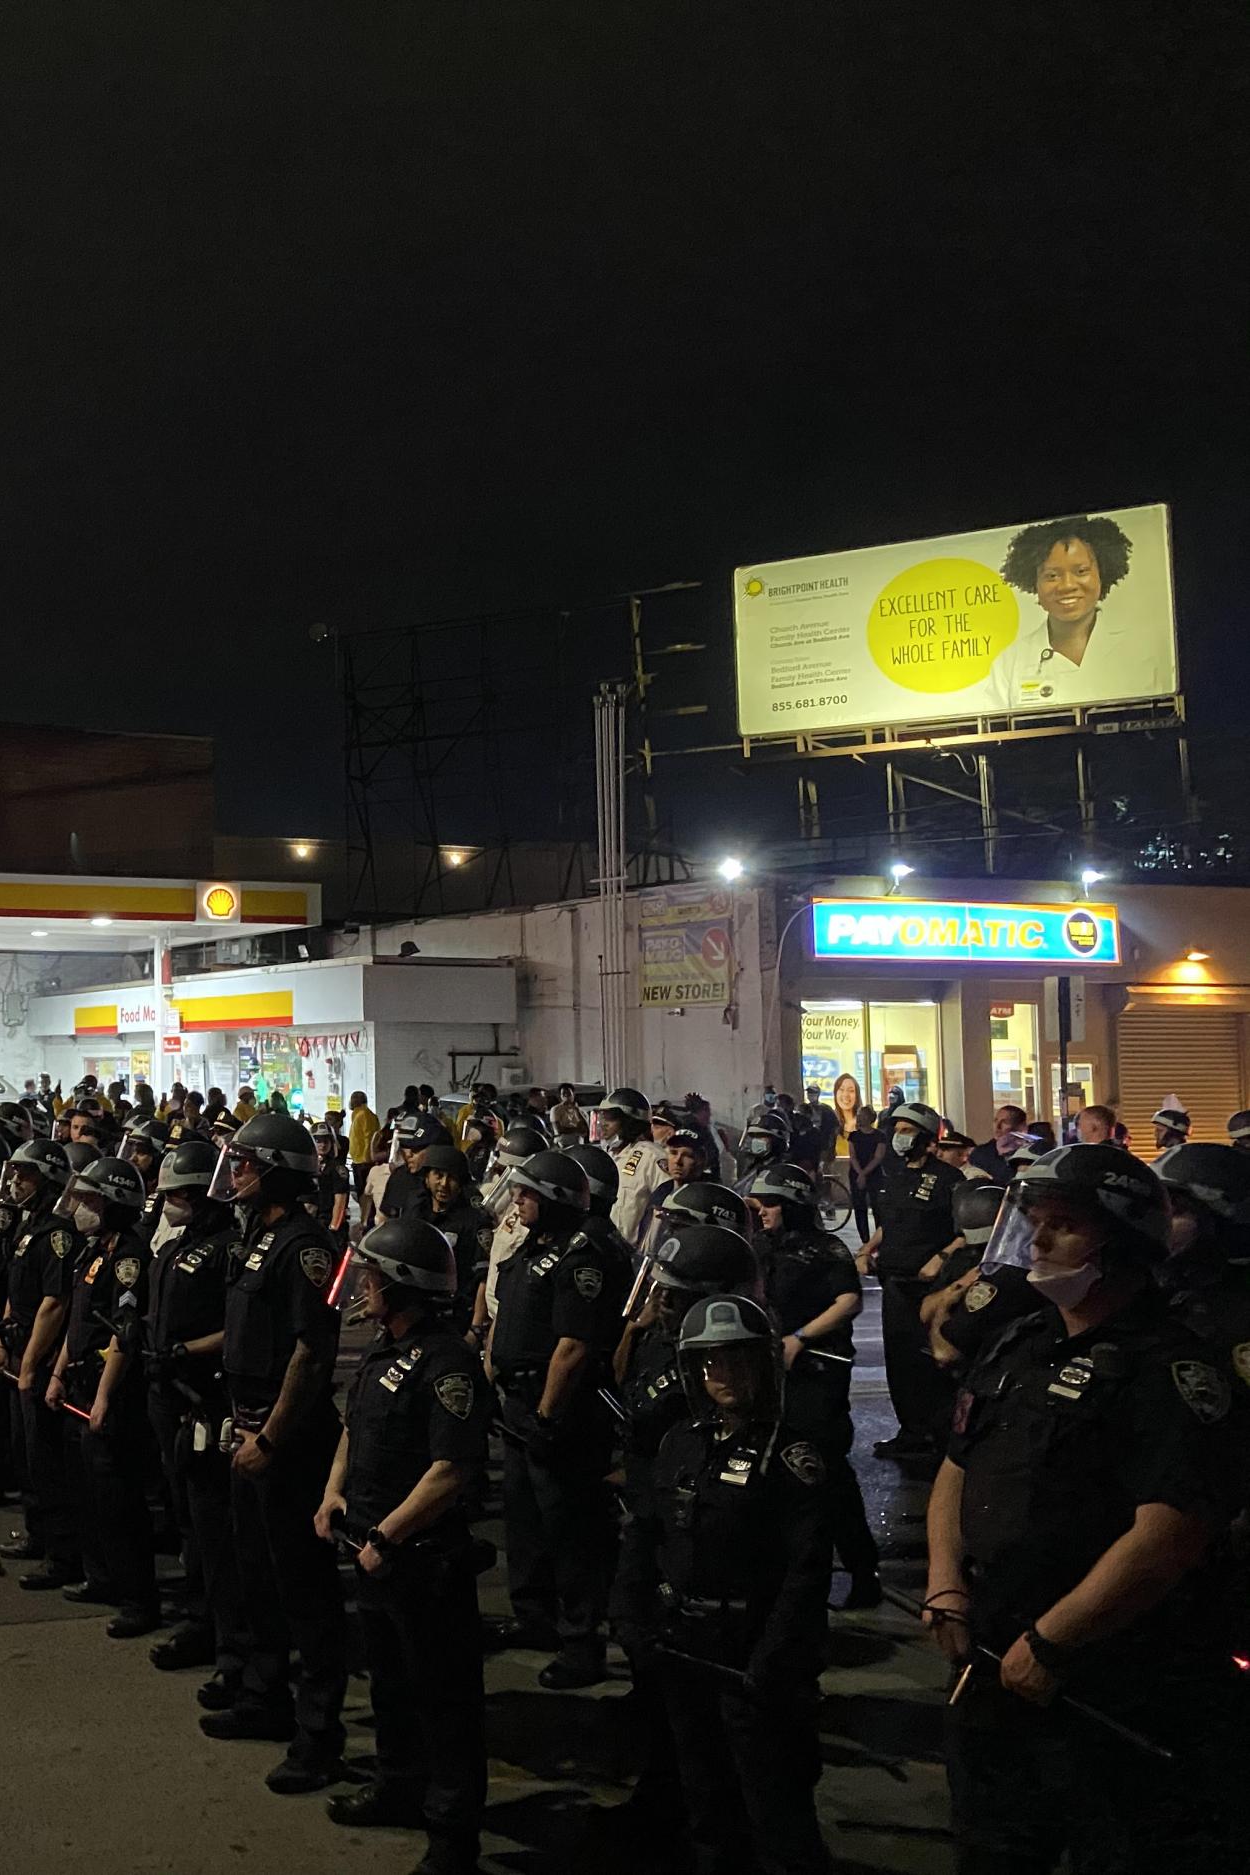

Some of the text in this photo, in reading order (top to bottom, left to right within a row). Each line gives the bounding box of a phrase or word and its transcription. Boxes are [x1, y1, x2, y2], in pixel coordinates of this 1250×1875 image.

[768, 577, 848, 597] BRIGHTPOINT HEALTH
[879, 588, 957, 617] EXCELLENT
[964, 584, 1001, 606] CARE
[909, 613, 972, 638] FOR THE
[891, 635, 991, 665] WHOLE FAMILY
[772, 694, 848, 712] 855.681.8700
[827, 914, 1044, 948] PAYOMATIC
[642, 982, 726, 1001] NEW STORE!
[120, 1005, 156, 1023] Food Ma
[990, 1007, 1012, 1015] ATM
[801, 1015, 860, 1030] Your Money.
[801, 1028, 849, 1043] Your Way.
